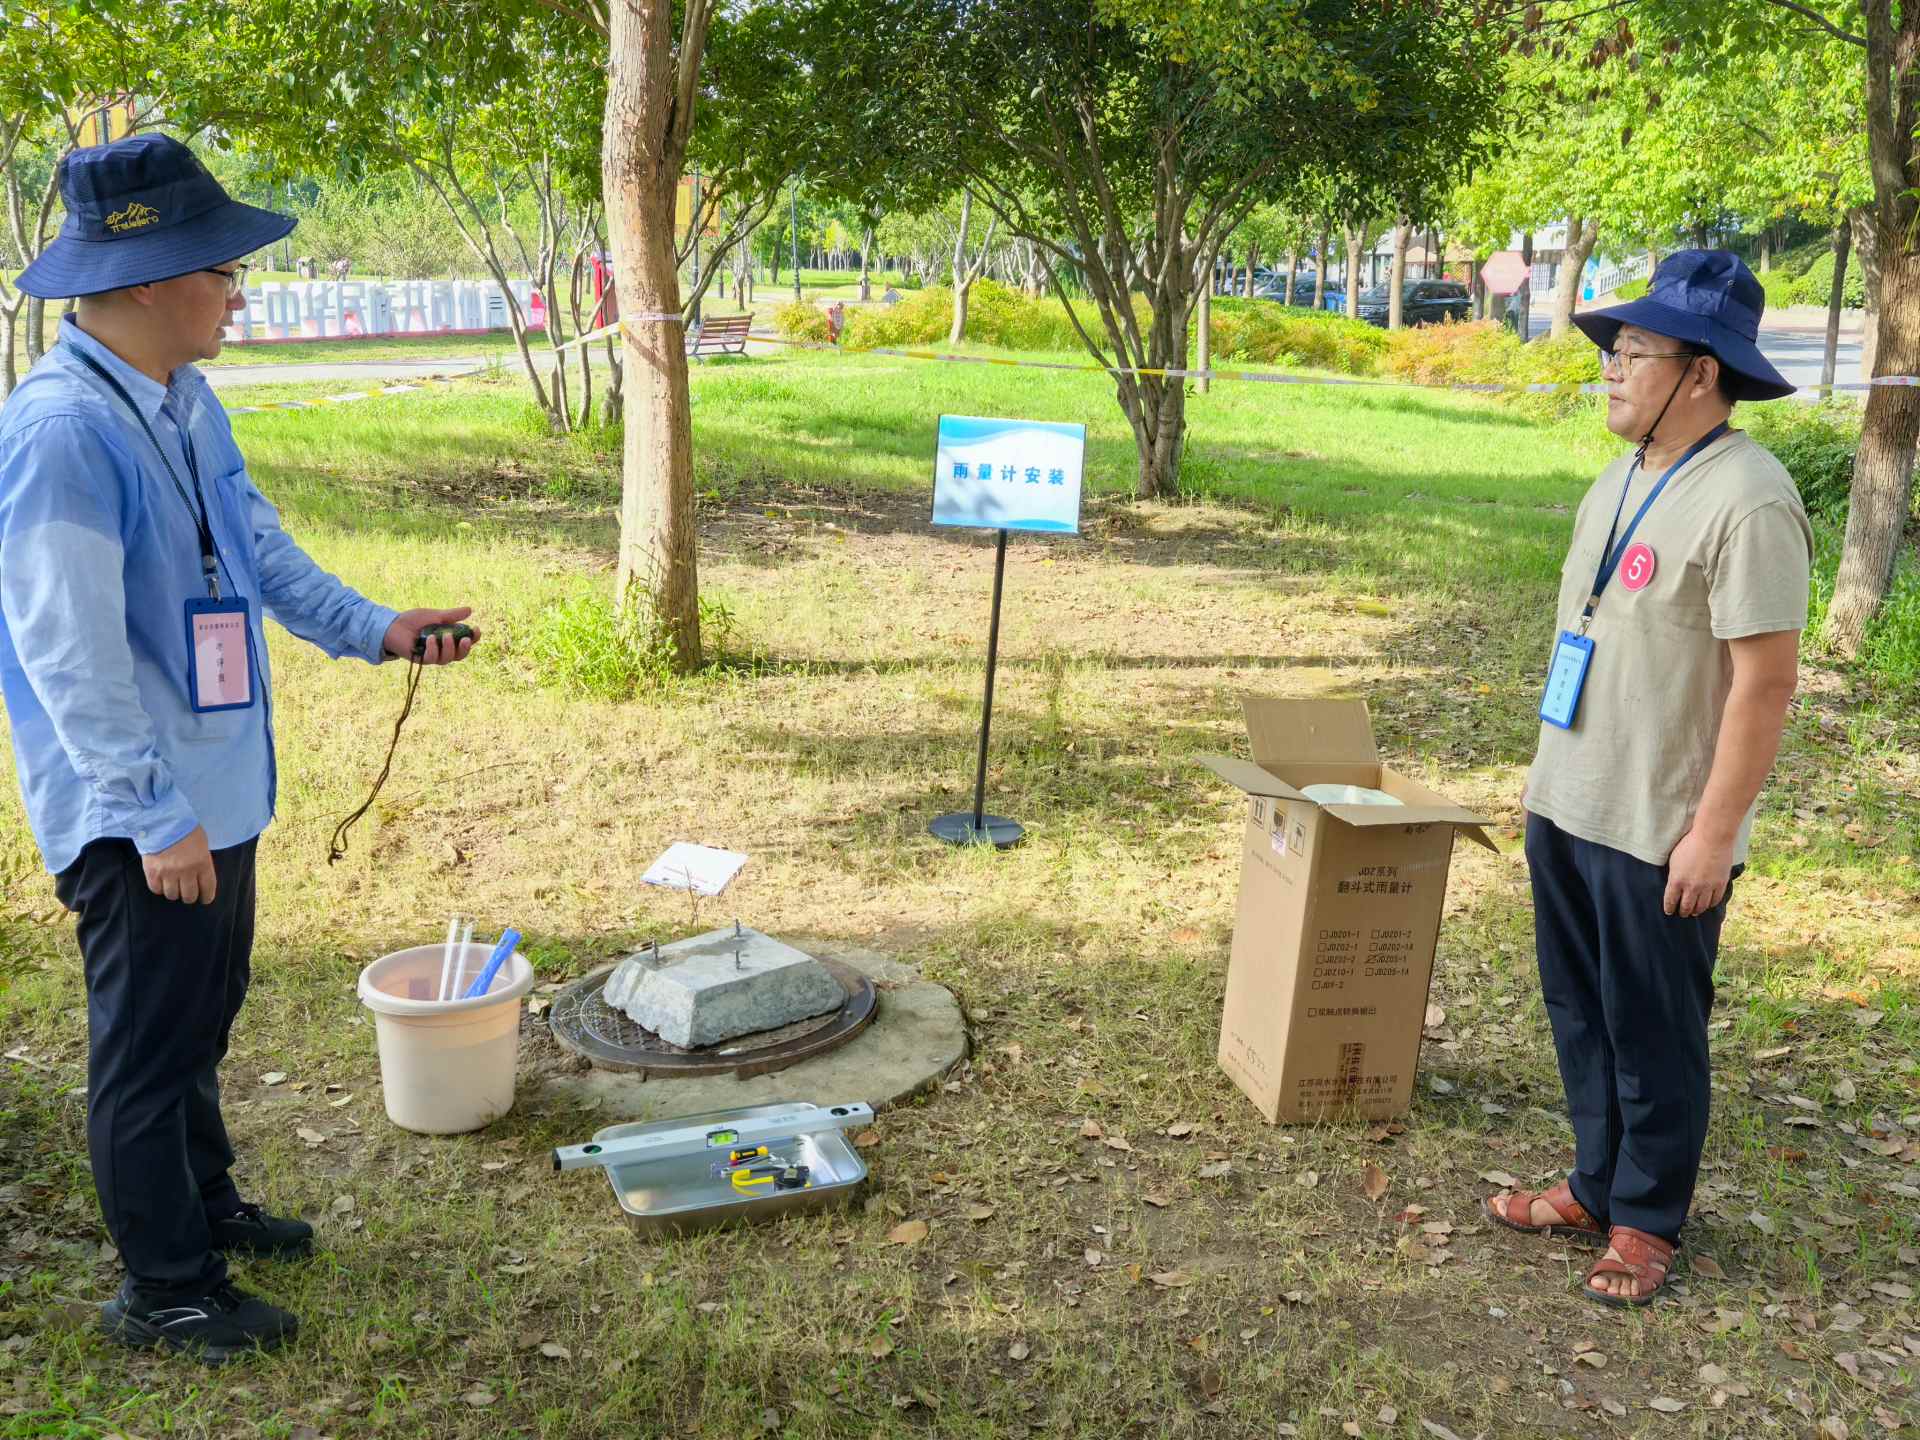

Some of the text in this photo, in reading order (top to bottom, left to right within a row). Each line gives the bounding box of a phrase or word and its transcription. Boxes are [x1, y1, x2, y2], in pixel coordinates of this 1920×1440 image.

[952, 462, 1066, 486] 雨量计安装
[1627, 553, 1647, 581] 5
[1337, 880, 1414, 895] 翻斗式雨量计
